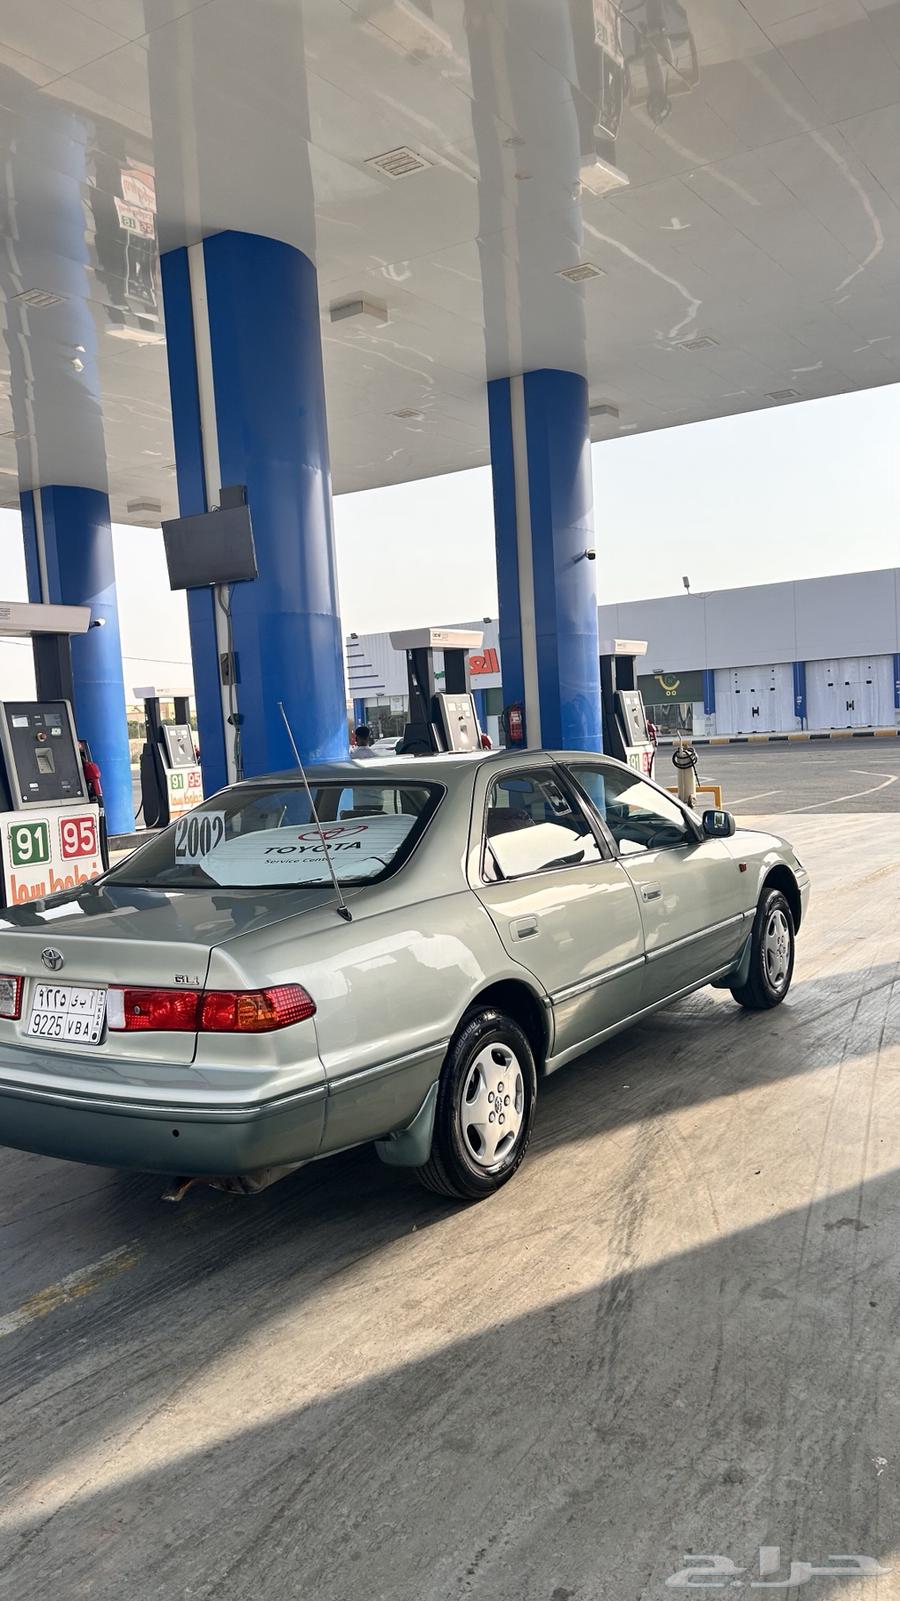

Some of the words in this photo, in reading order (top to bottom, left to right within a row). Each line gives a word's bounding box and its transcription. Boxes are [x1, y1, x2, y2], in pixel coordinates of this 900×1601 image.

[171, 774, 183, 789] 91
[188, 773, 200, 787] 95
[16, 826, 45, 860] 91
[63, 820, 95, 854] 95
[175, 816, 223, 857] 2002
[264, 841, 361, 854] TOYOTA
[32, 1013, 63, 1036] 9225
[67, 1020, 89, 1036] VBA
